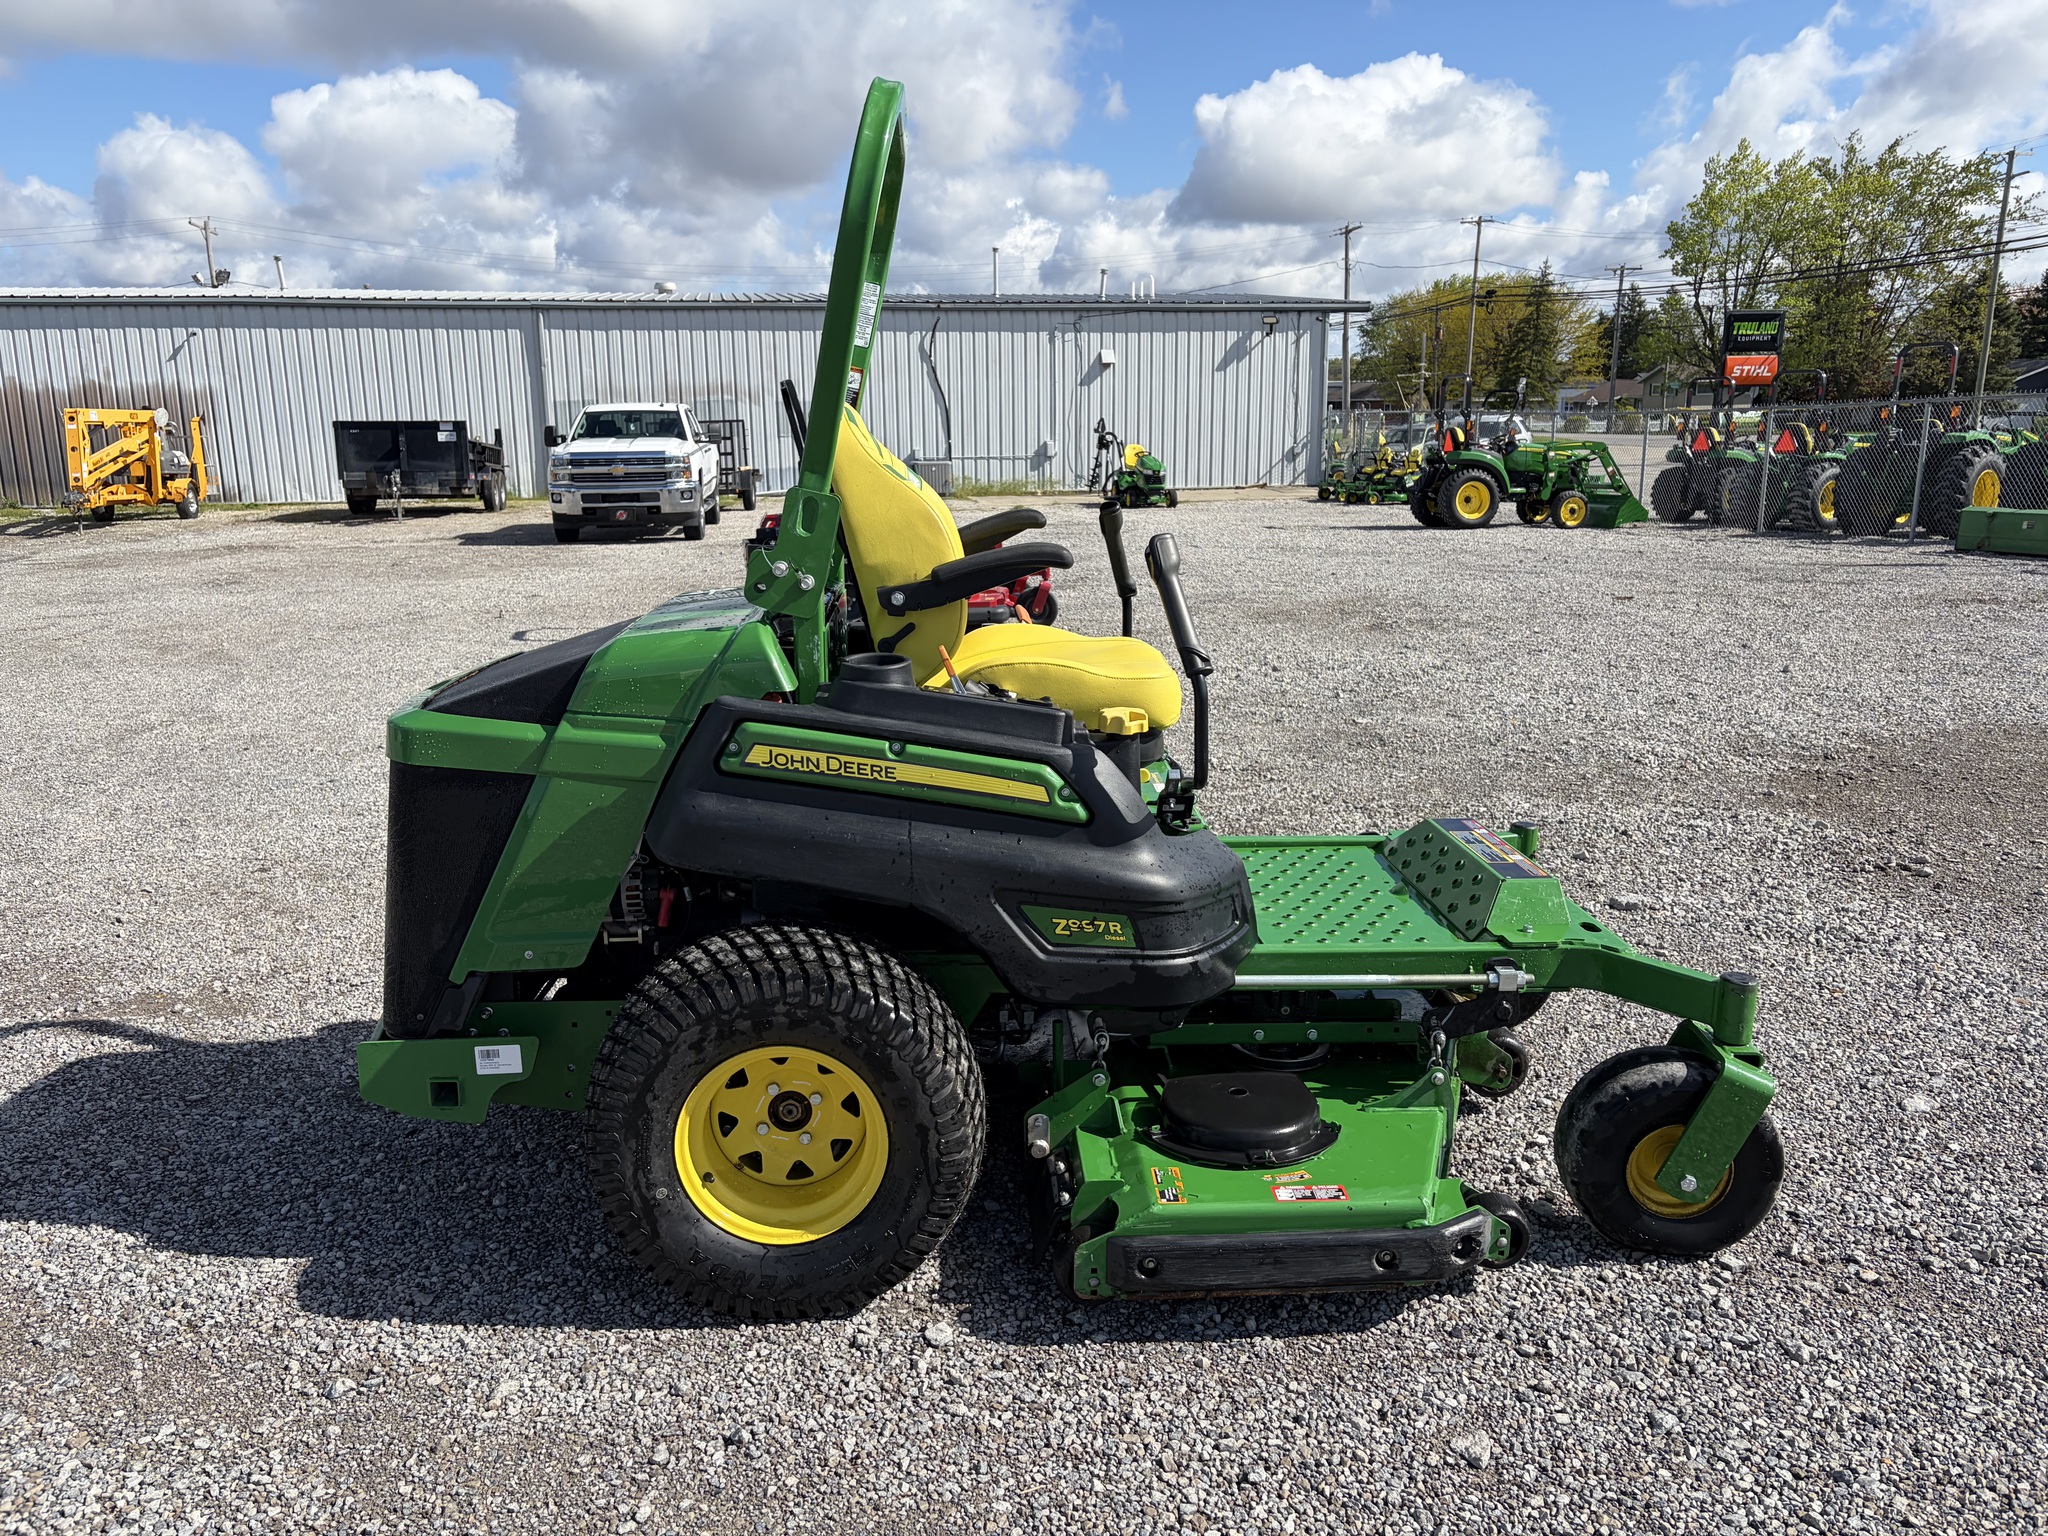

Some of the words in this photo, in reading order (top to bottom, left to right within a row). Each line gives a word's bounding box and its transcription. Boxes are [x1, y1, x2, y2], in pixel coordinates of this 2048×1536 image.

[1732, 321, 1779, 335] TRULAND
[1731, 365, 1772, 377] STIHL
[761, 749, 820, 771] JOHN
[825, 755, 897, 780] DEERE
[689, 1248, 804, 1290] KENDA
